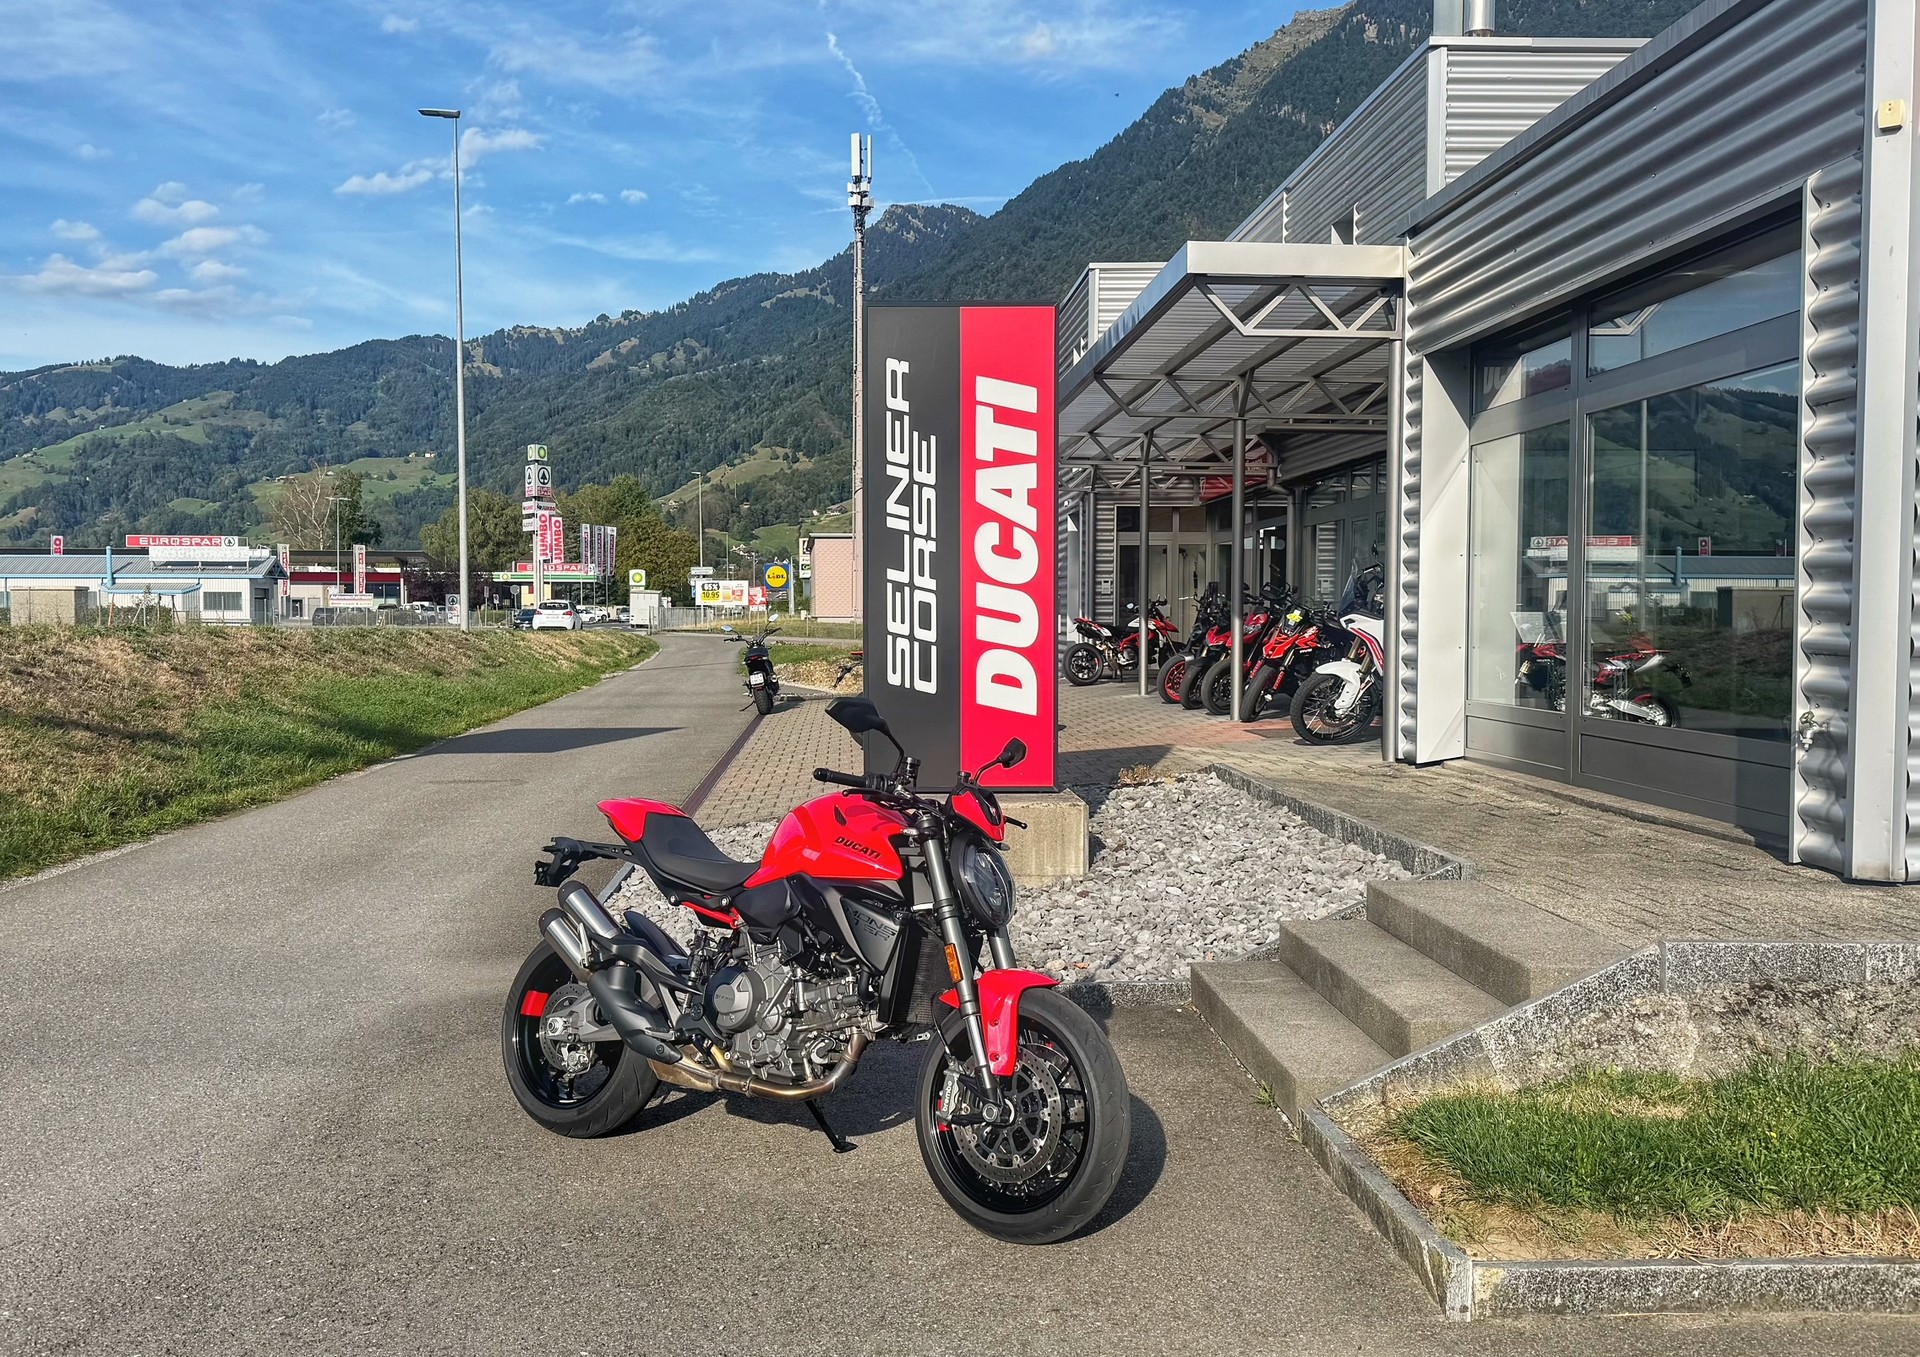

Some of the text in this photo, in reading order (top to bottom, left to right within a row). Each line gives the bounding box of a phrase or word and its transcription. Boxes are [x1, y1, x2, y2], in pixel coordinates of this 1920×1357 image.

[139, 537, 222, 546] EUROSPAR
[539, 513, 548, 558] JUMBO
[553, 519, 562, 561] JUMBO
[886, 357, 910, 689] SELINER
[912, 430, 937, 694] CORSE
[974, 375, 1039, 717] DUCATI
[835, 836, 881, 859] DUCATI
[941, 1080, 953, 1112] brembo
